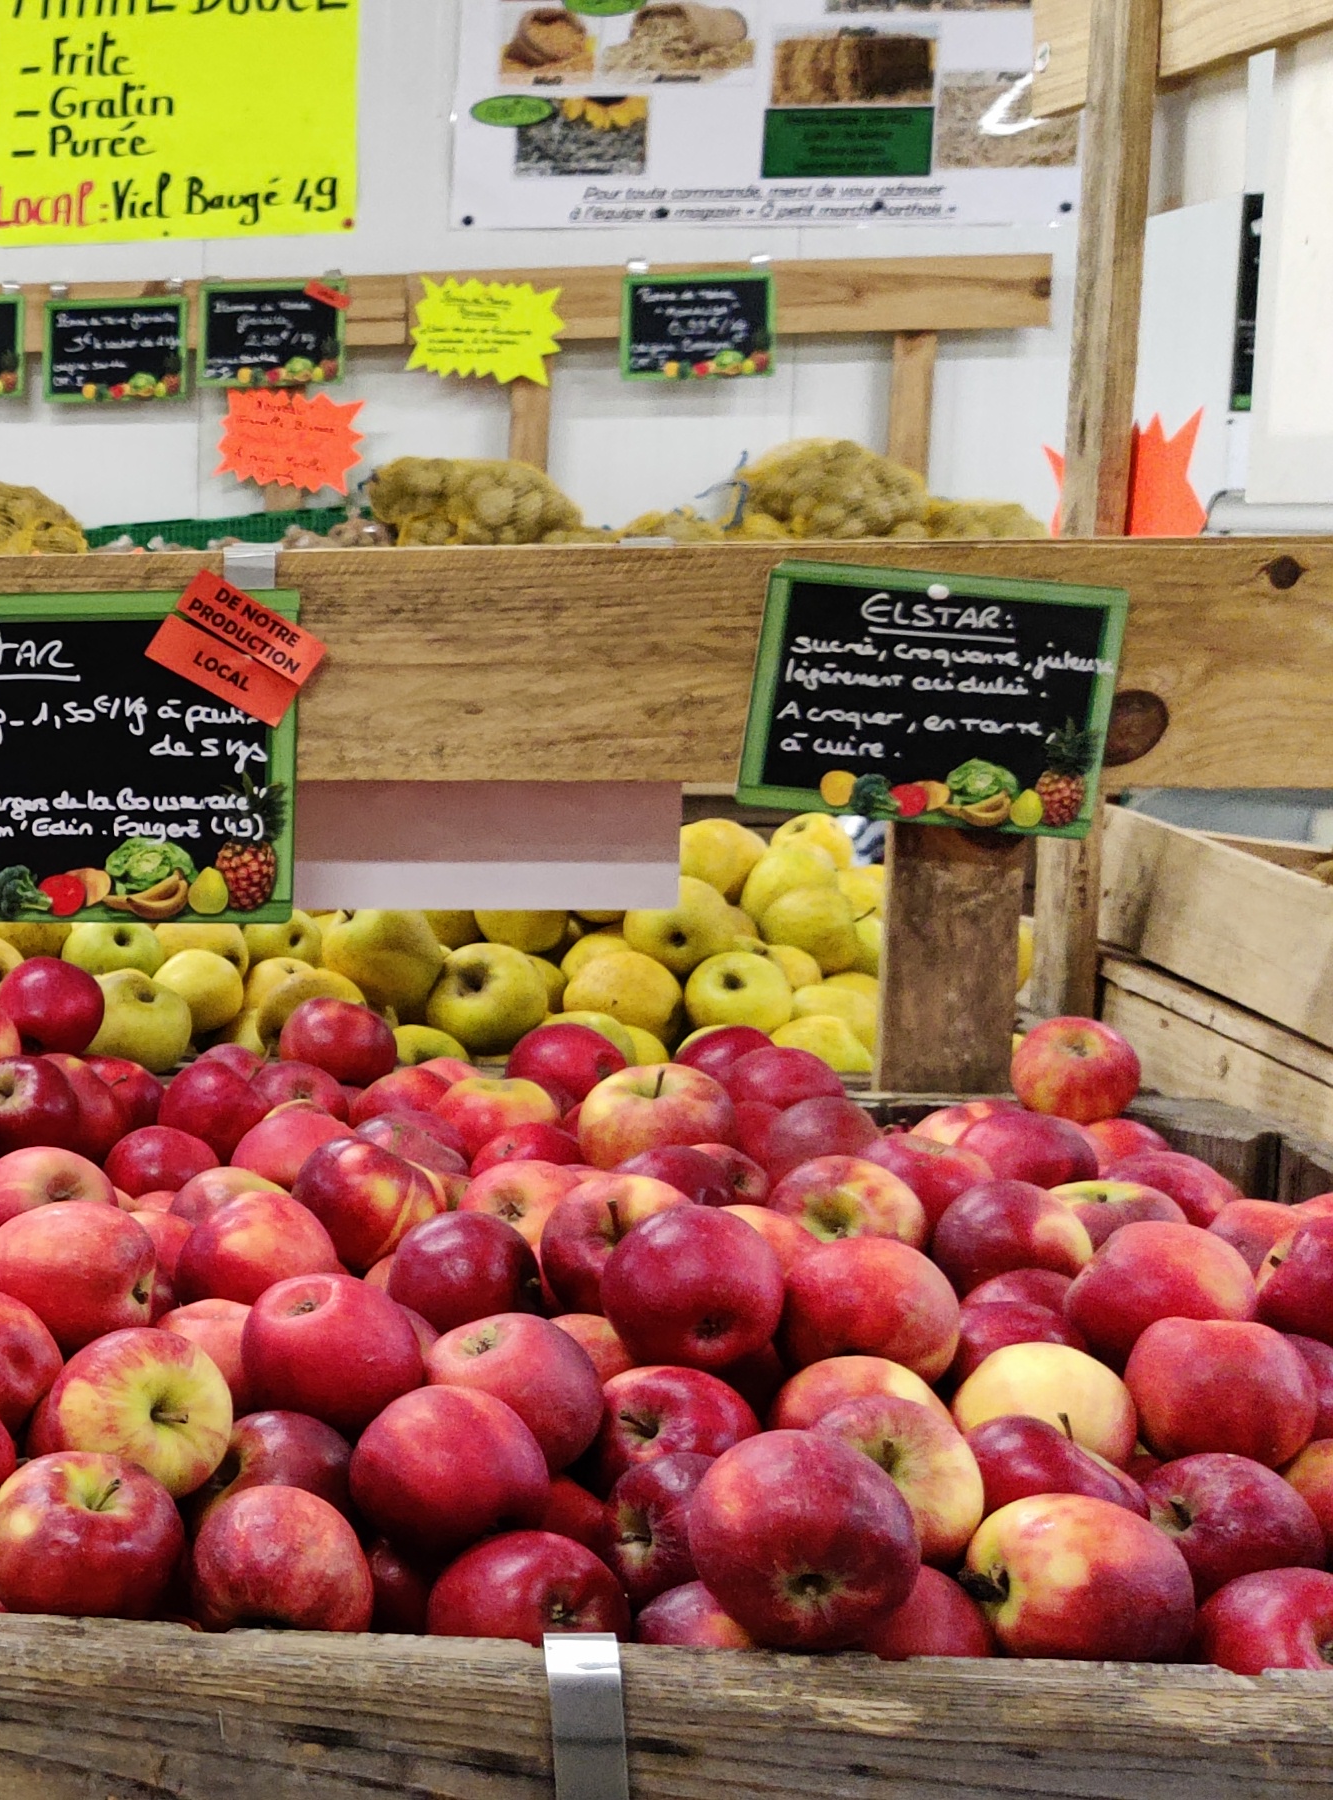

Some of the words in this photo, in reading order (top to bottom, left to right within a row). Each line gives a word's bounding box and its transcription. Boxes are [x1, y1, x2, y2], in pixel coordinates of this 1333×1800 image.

[51, 30, 134, 77] Frite
[50, 82, 175, 119] Gratin
[49, 121, 157, 158] Purée
[184, 176, 284, 226] Baugé
[293, 176, 339, 213] 49
[188, 597, 301, 674] PRODUCTION
[215, 588, 242, 611] DE
[241, 604, 300, 648] NOTRE
[193, 651, 249, 691] LOCAL
[149, 734, 194, 756] de
